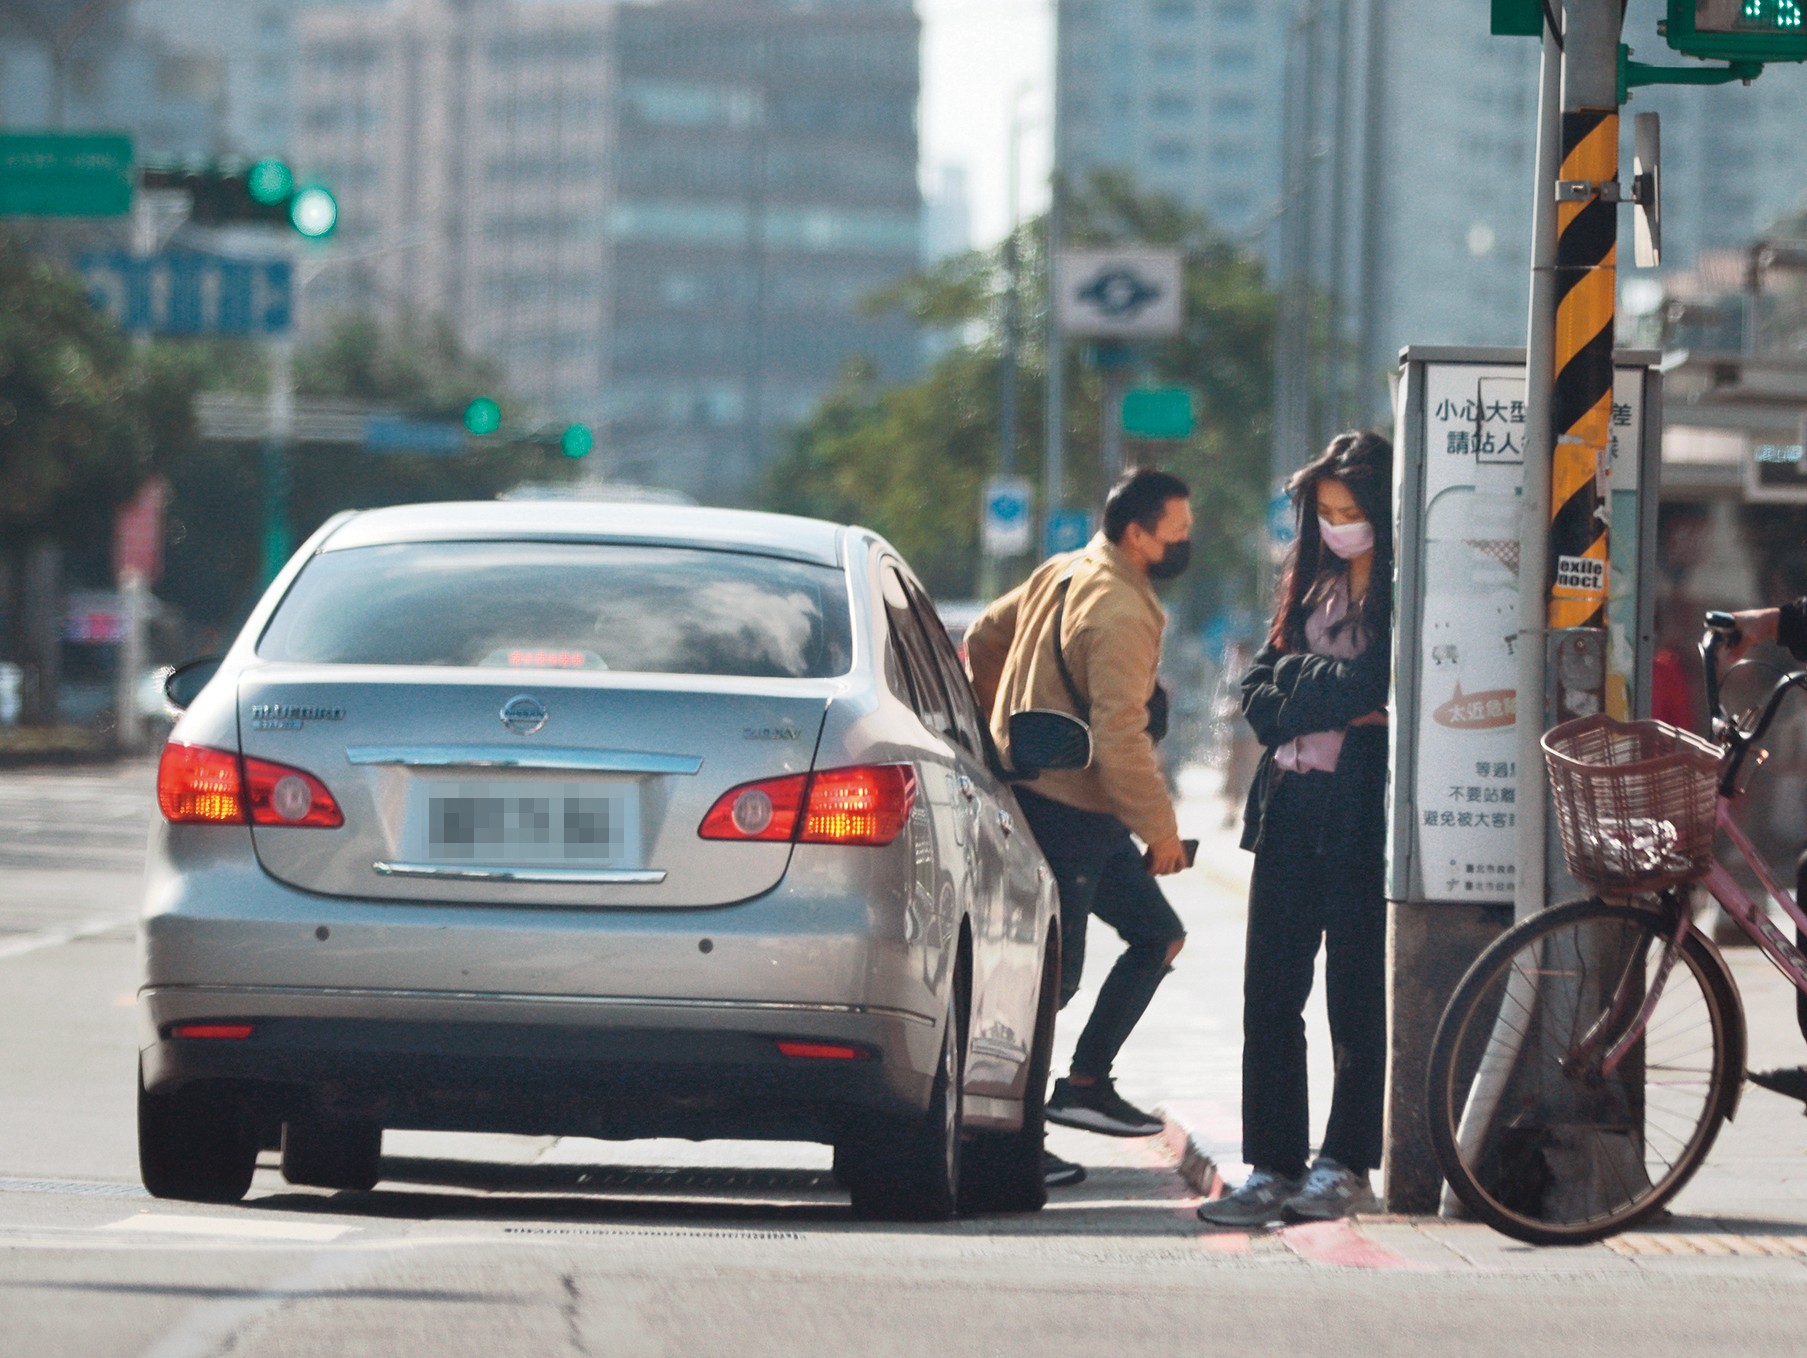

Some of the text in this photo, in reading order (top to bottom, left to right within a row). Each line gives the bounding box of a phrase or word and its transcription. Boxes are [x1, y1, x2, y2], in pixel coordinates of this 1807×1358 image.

[1446, 430, 1530, 455] 請站人
[1560, 560, 1602, 575] exile
